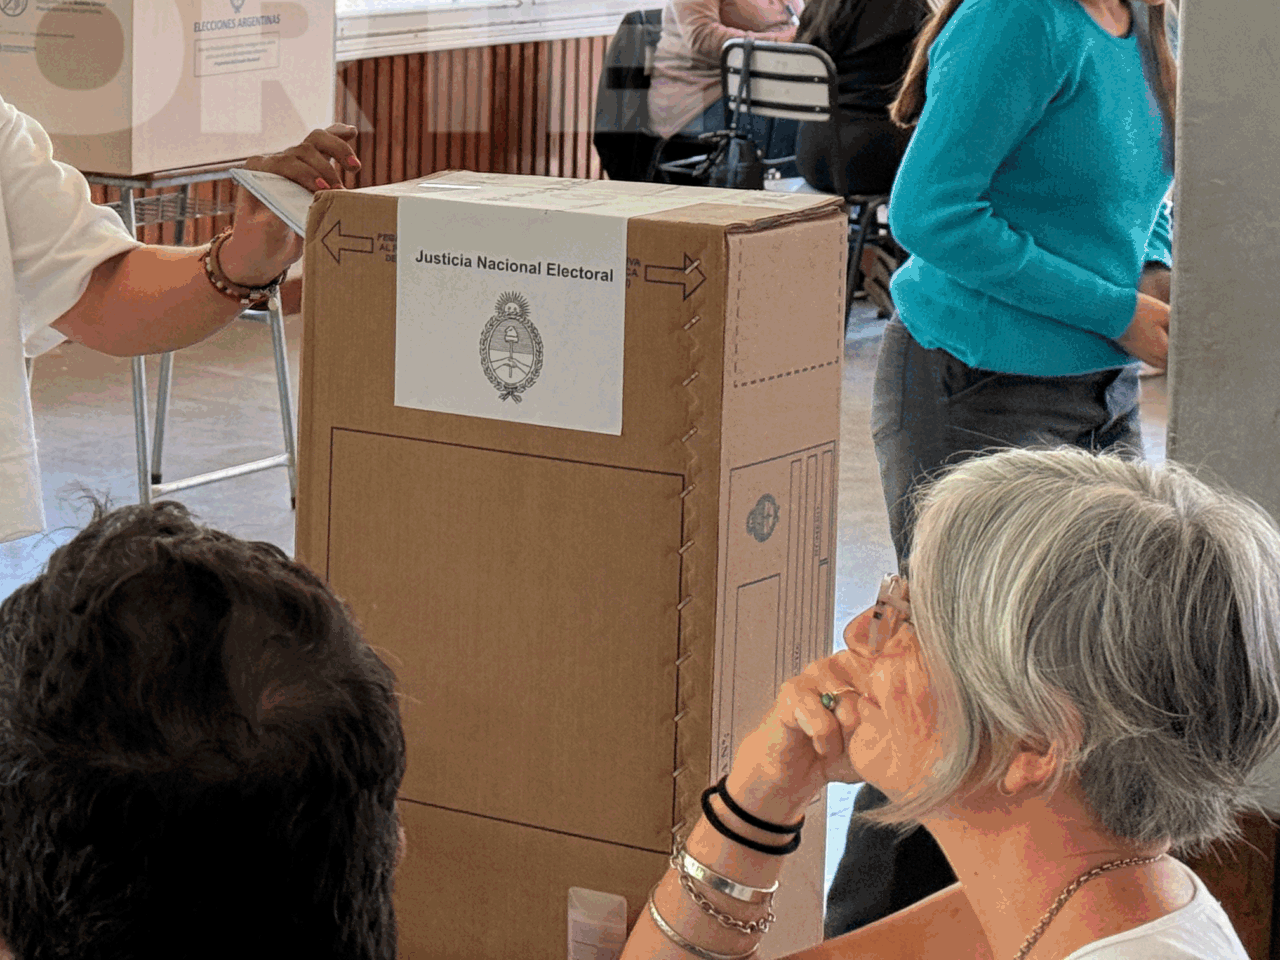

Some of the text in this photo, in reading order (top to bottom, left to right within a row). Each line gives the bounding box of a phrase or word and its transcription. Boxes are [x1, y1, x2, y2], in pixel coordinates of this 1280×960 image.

[194, 14, 280, 32] ELECCIONES ARGENTINAS
[416, 249, 614, 282] Justicia Nacional Electoral
